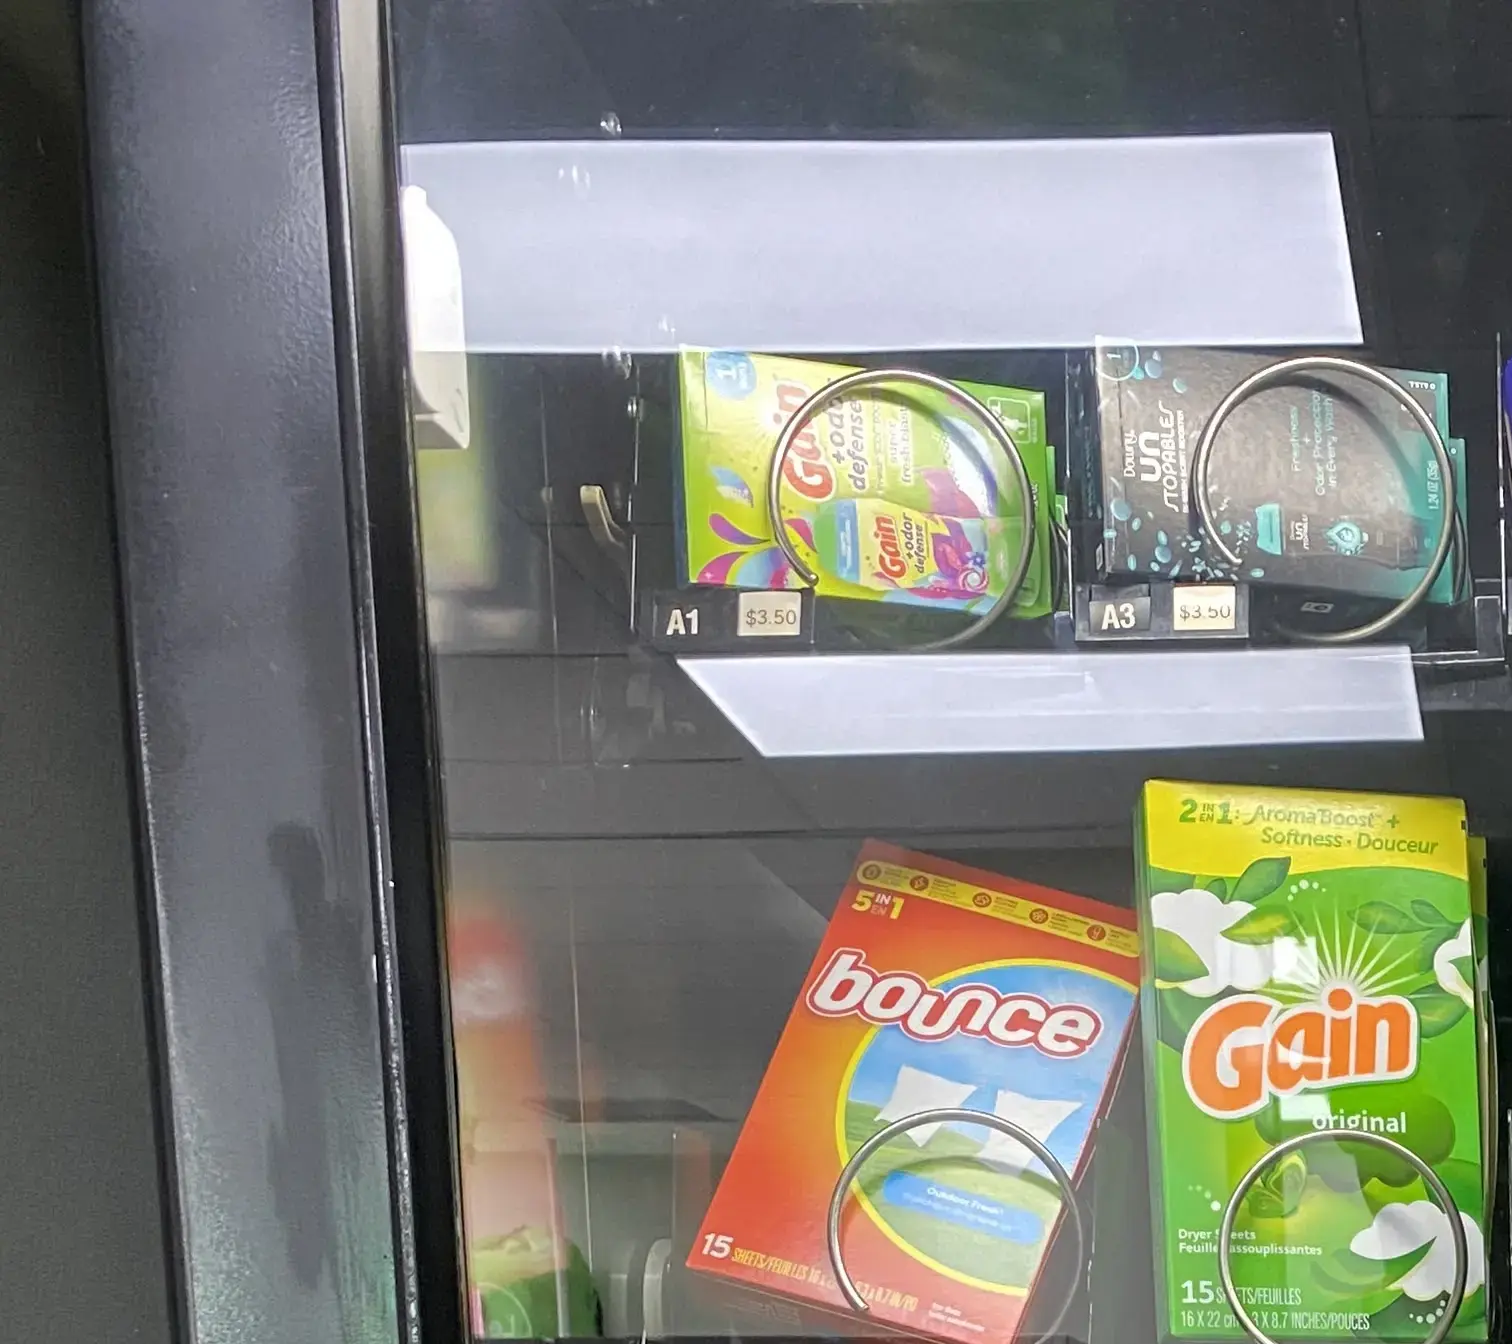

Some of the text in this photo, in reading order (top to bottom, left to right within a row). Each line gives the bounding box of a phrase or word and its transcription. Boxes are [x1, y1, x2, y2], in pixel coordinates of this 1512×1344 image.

[773, 382, 833, 499] Gain
[878, 514, 908, 579] Gain
[665, 609, 699, 634] A1
[745, 608, 797, 626] $3.50
[1101, 602, 1136, 630] A3
[1179, 799, 1198, 823] 2
[1261, 827, 1439, 855] Softness Douceur
[850, 889, 905, 920] 5 IN 1
[807, 948, 1104, 1059] bounce
[1183, 986, 1417, 1121] Gain
[1312, 1109, 1407, 1134] original
[701, 1232, 734, 1259] 15
[1178, 1228, 1212, 1242] Dryer
[1181, 1279, 1214, 1304] 15
[1180, 1310, 1221, 1328] 16 22
